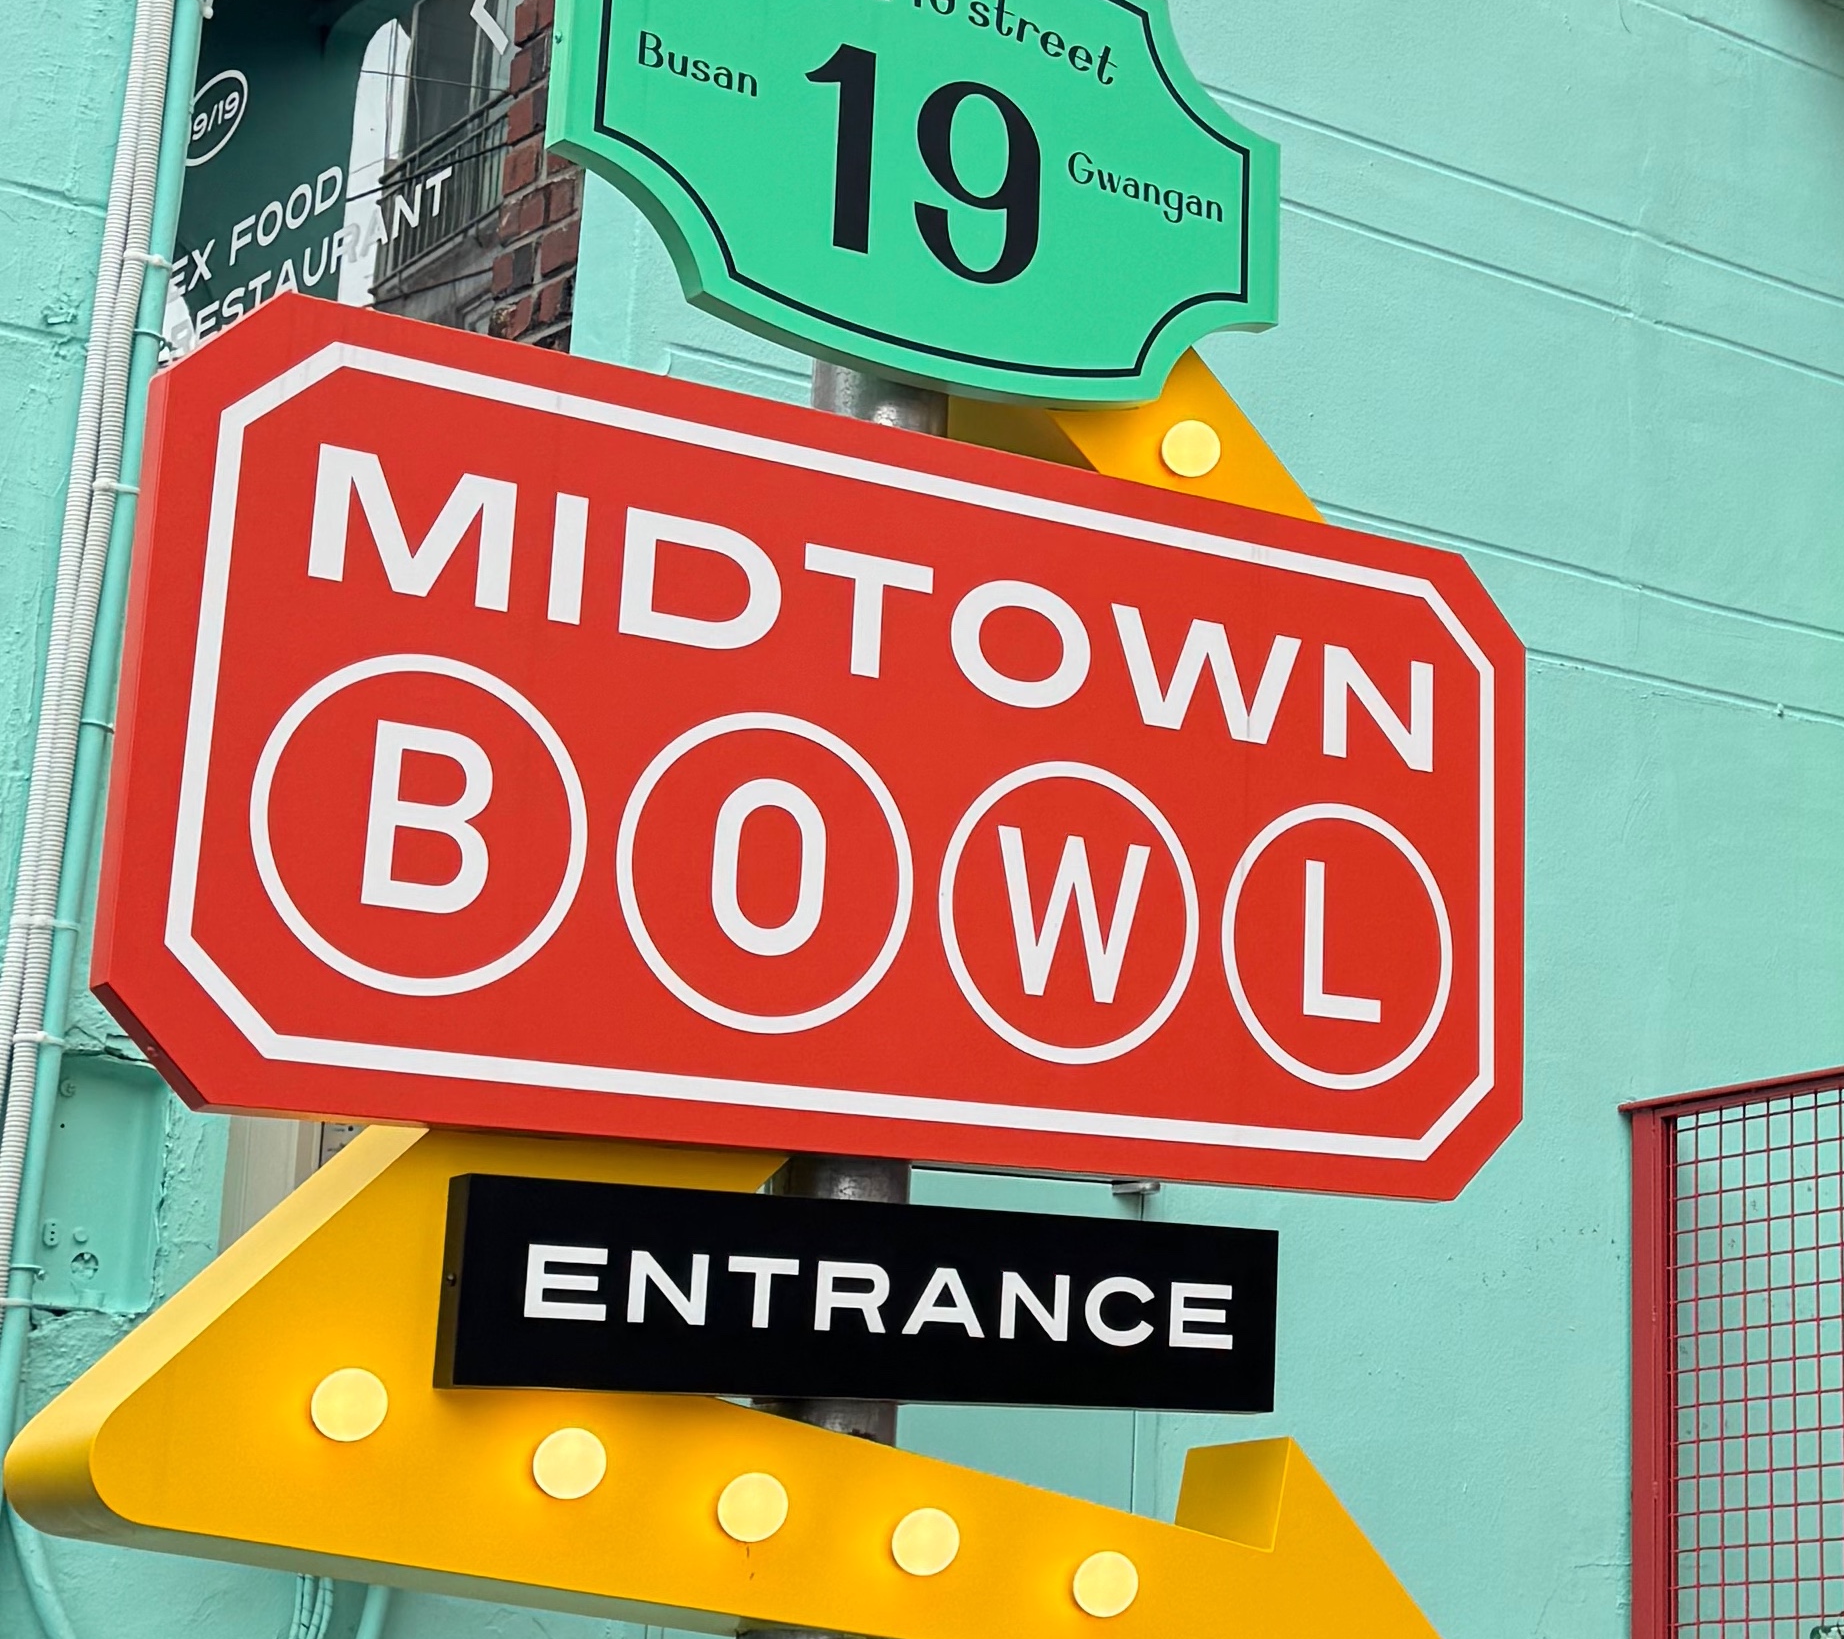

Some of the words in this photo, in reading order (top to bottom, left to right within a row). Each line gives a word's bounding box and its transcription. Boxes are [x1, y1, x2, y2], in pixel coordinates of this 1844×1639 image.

[637, 30, 760, 99] Busan
[229, 165, 343, 266] FOOD
[804, 42, 1041, 285] 19
[1067, 151, 1225, 224] Gwangan
[306, 442, 1434, 773] MIDTOWN
[358, 718, 1383, 1023] BOWL
[522, 1242, 1235, 1353] ENTRANCE
